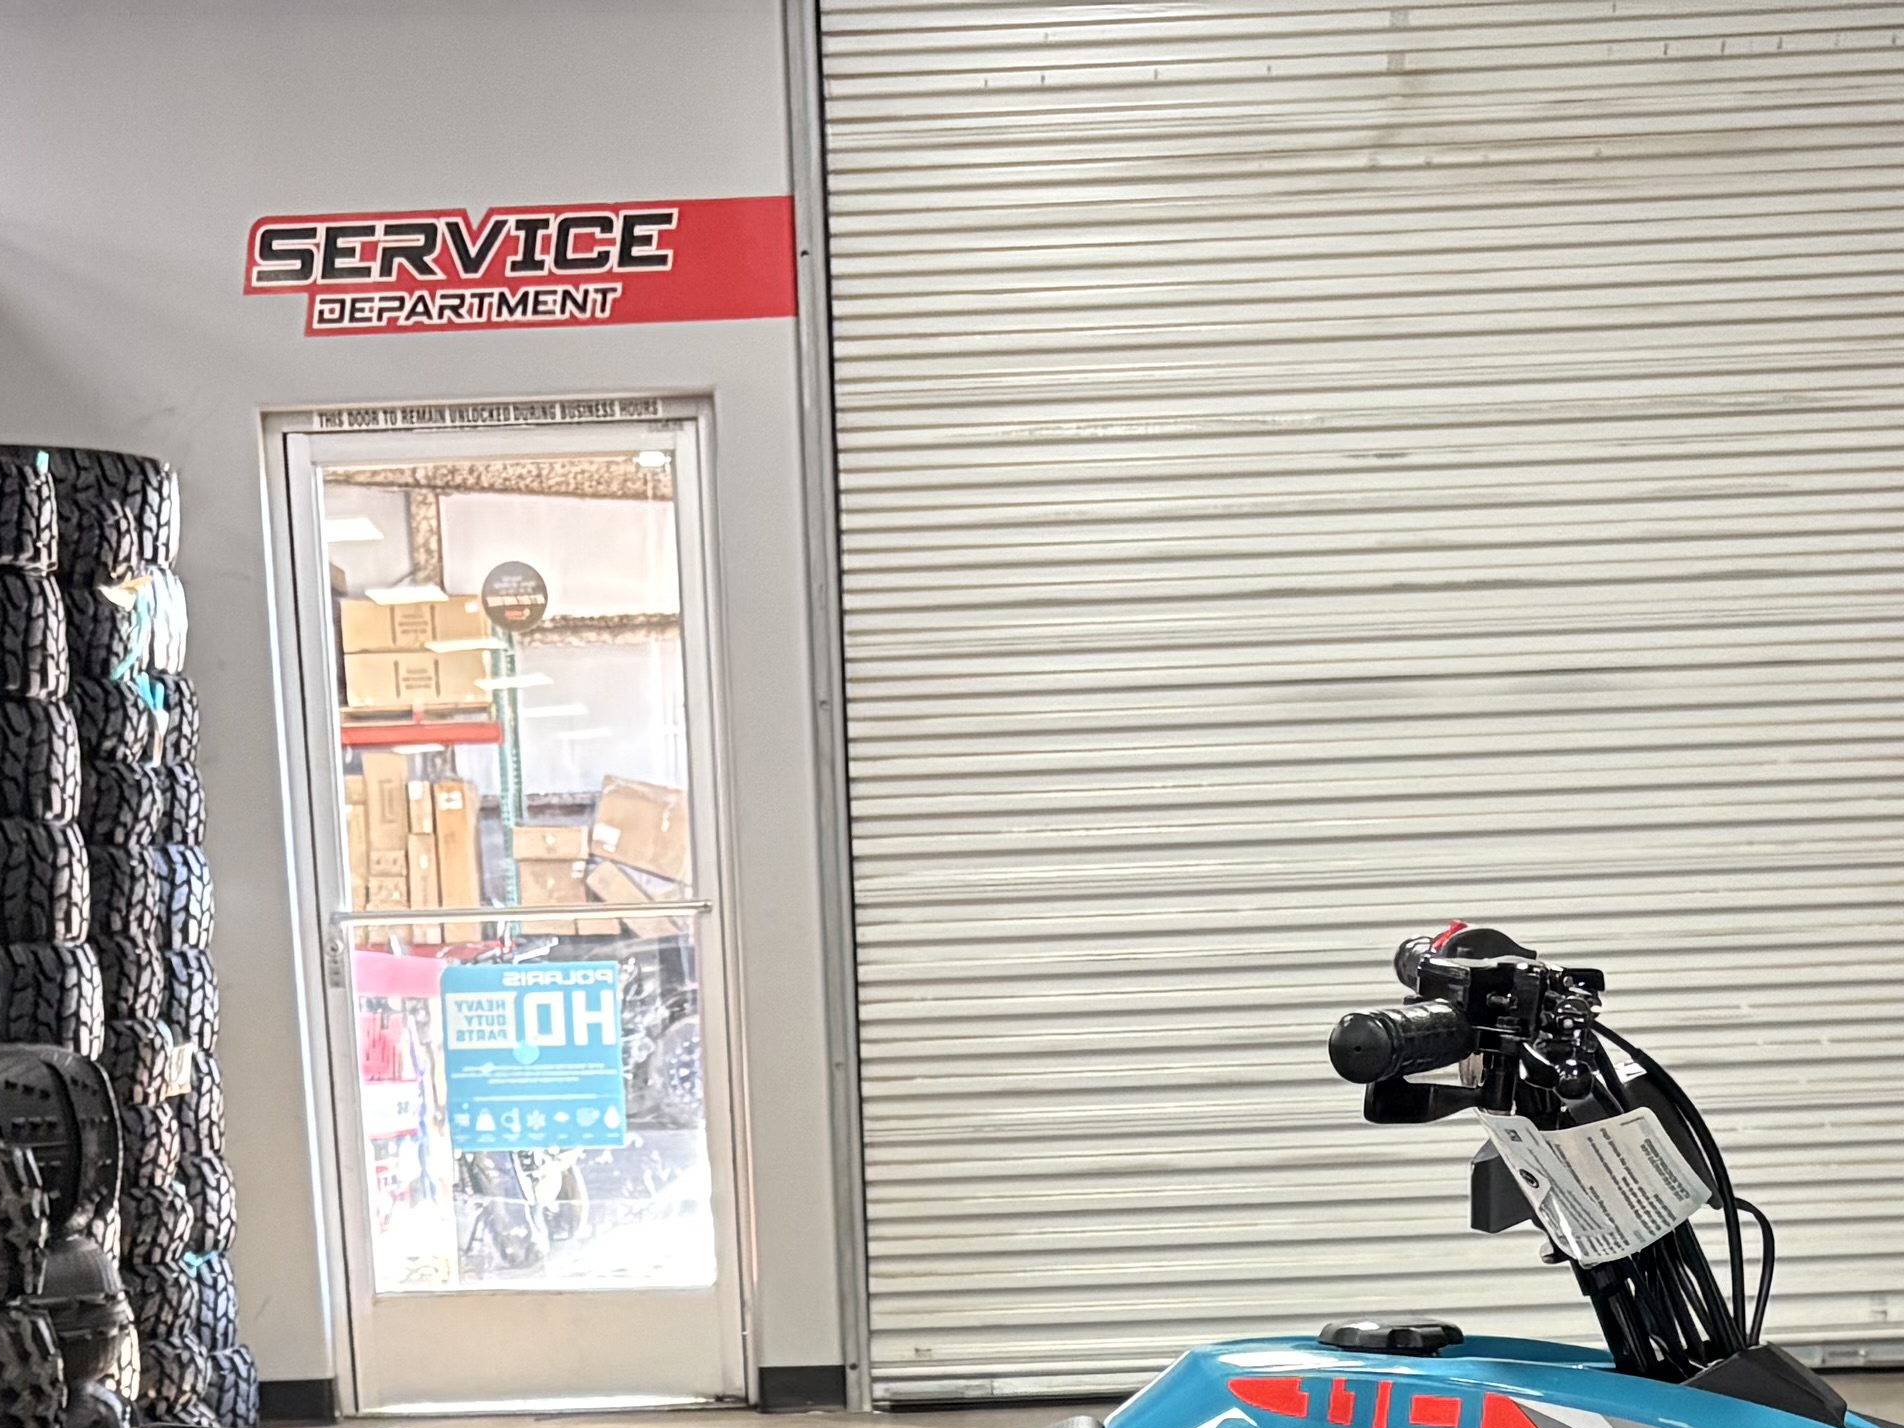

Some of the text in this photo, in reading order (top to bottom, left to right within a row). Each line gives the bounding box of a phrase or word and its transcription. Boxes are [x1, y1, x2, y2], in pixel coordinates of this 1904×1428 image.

[251, 209, 678, 287] SERVICE
[314, 283, 622, 328] DEPARTMENT
[318, 400, 660, 428] THIS DOOR TO REMAIN UNLOCKED DURING BUSINESS HOURS
